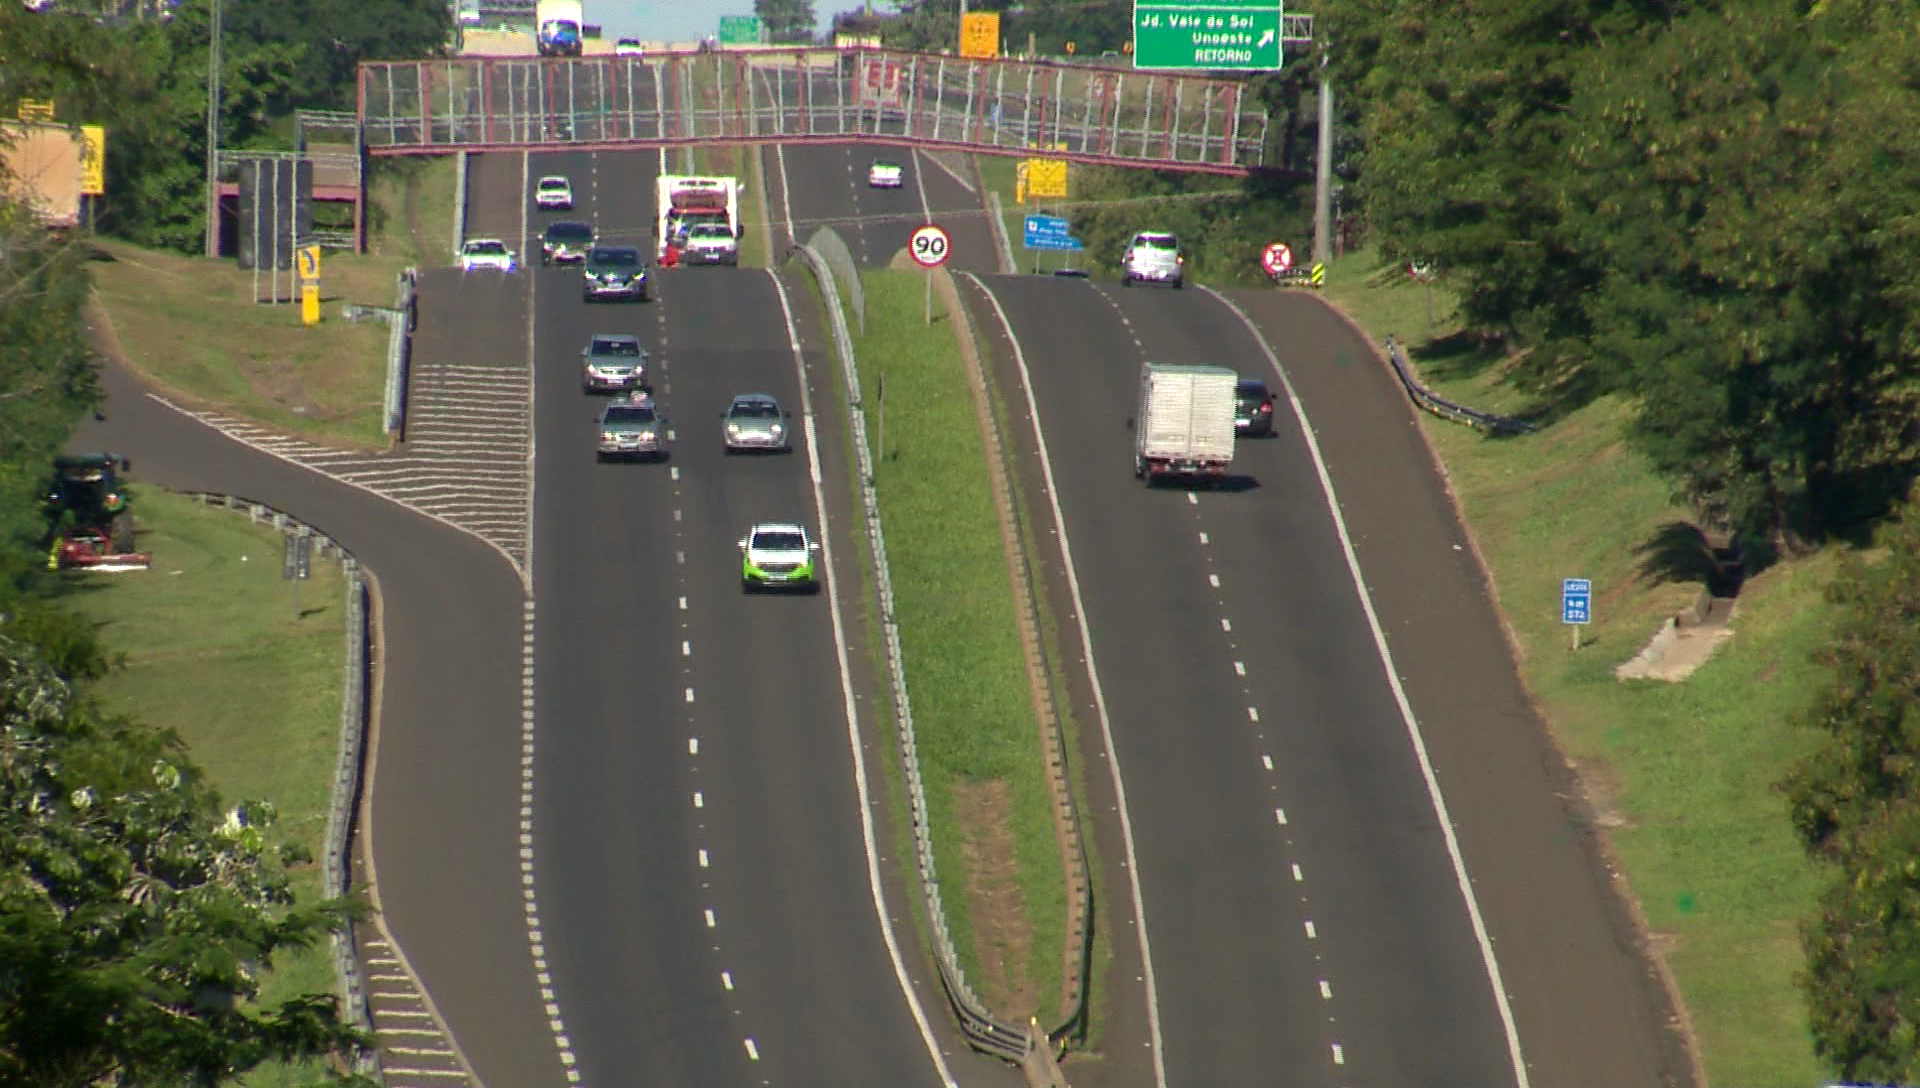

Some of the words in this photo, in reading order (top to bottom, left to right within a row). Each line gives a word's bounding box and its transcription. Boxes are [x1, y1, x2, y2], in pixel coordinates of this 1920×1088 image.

[1140, 13, 1163, 28] Jd.
[1168, 14, 1200, 28] Vale
[1229, 15, 1254, 29] Sol
[1192, 32, 1252, 45] Unoeste
[1194, 49, 1252, 62] RETORNO
[915, 236, 945, 254] 90
